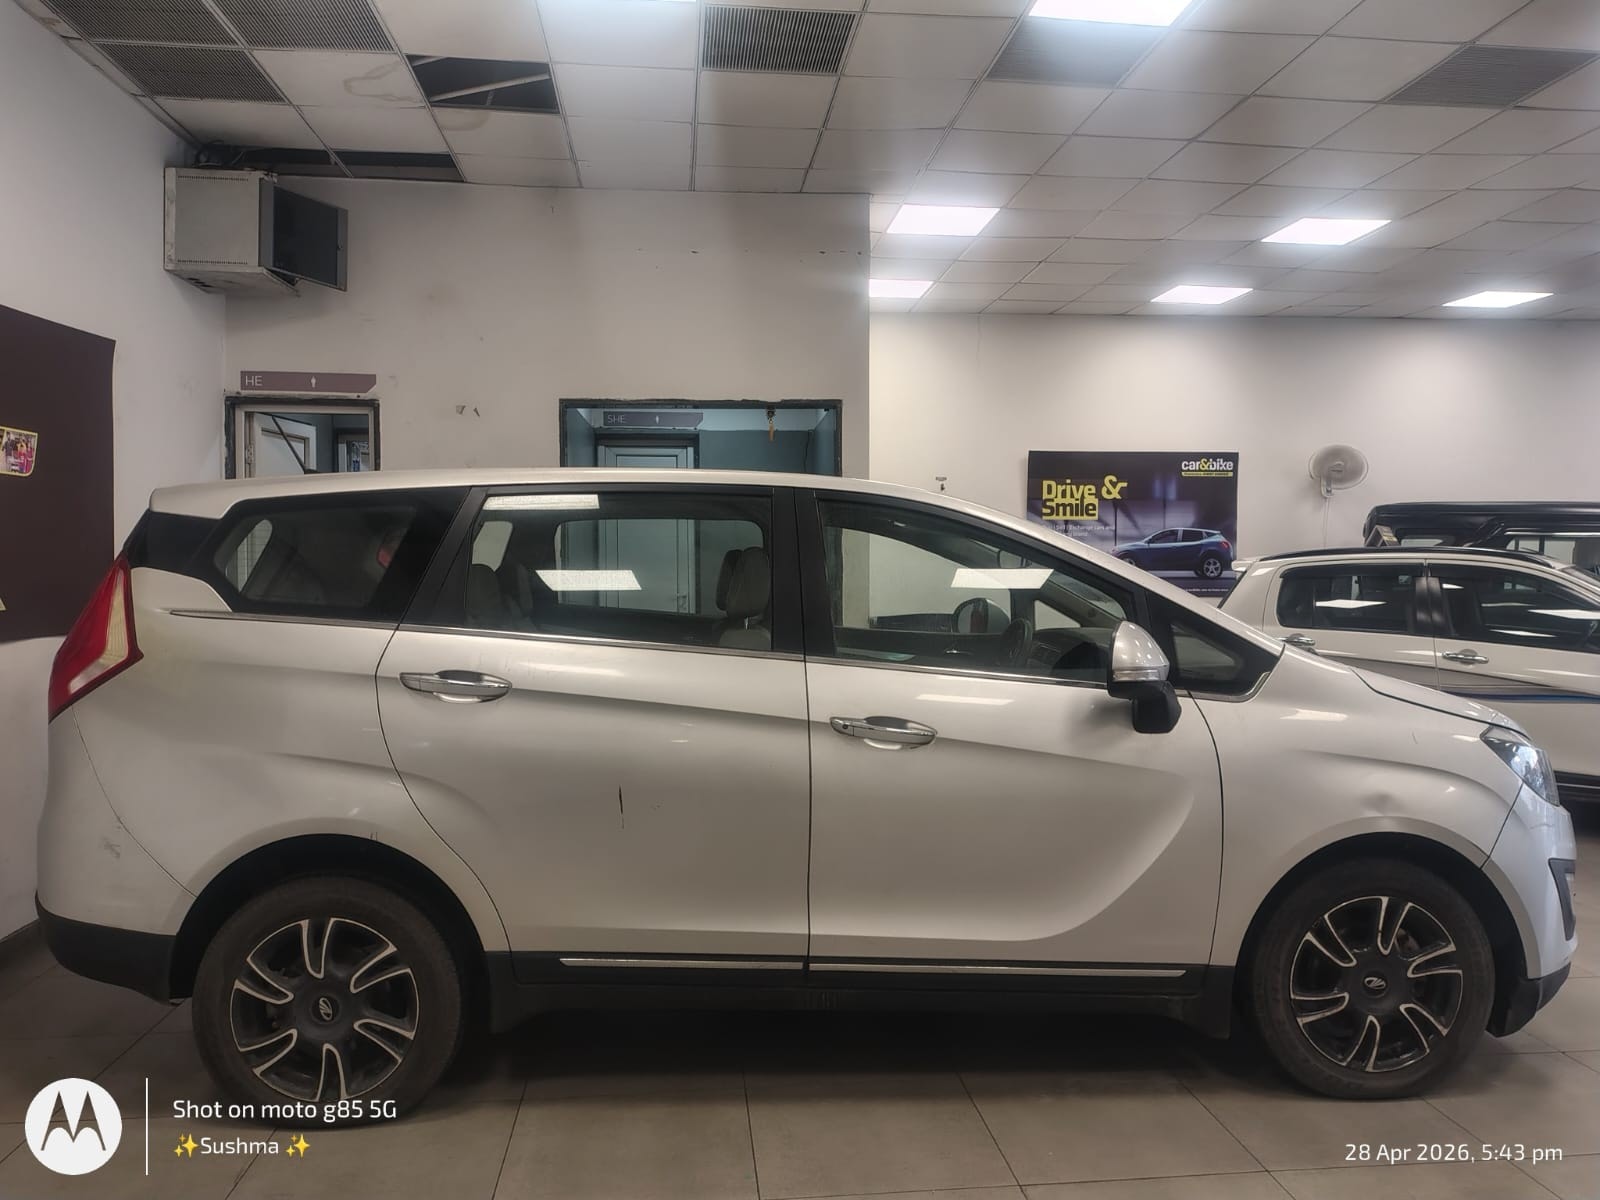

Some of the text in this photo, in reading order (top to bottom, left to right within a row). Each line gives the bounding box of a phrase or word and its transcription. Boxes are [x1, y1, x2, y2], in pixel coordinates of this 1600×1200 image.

[245, 375, 263, 387] HE
[607, 414, 626, 424] SHE
[1181, 458, 1234, 471] car&bike
[1042, 475, 1128, 500] Drive &
[1042, 499, 1097, 517] Smile
